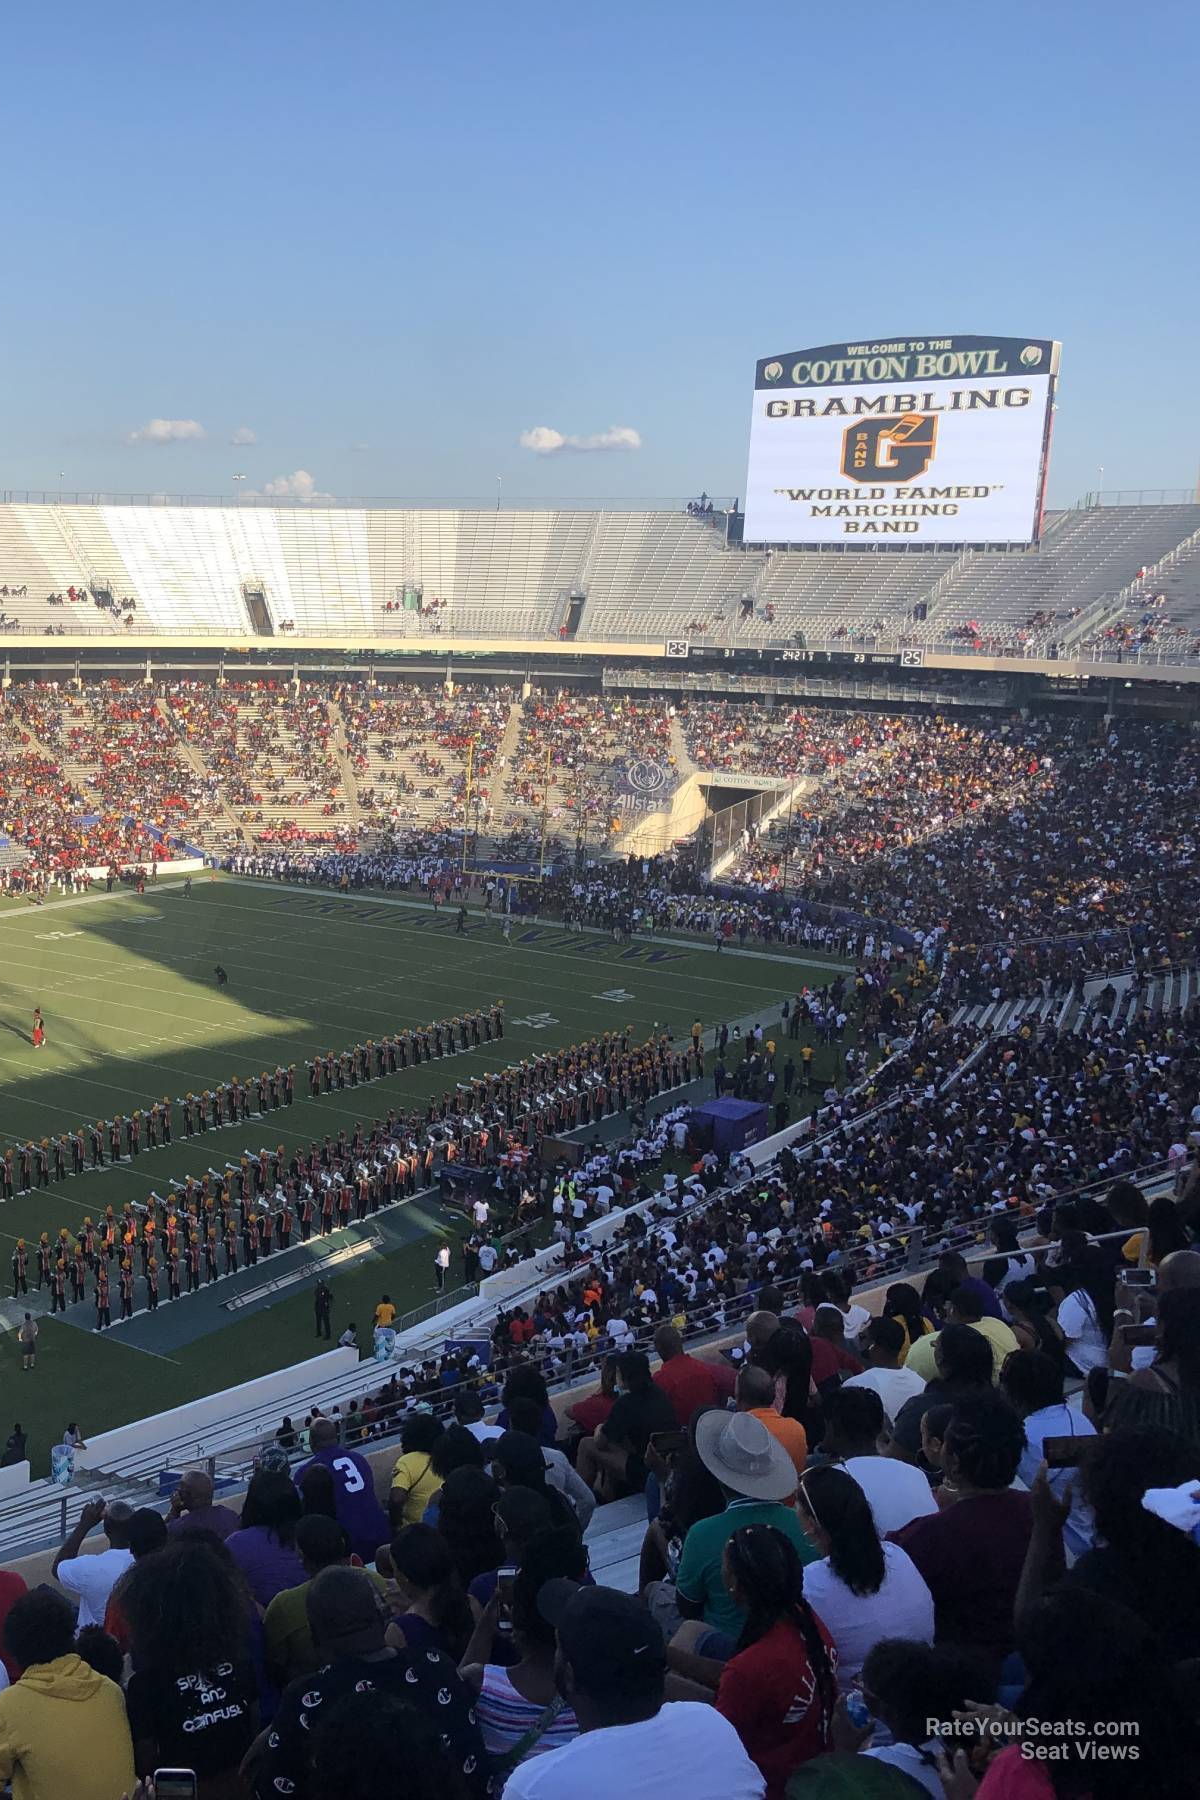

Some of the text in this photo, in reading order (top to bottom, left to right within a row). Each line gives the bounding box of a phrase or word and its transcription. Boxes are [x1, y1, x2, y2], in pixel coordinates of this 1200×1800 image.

[847, 339, 953, 356] WELCOME TO THE
[792, 350, 1007, 384] COTTON BOWL
[766, 387, 1032, 418] GRAMBLING
[854, 432, 868, 468] BAND
[810, 503, 959, 517] MARCHING
[843, 521, 920, 533] BAND
[669, 642, 686, 655] 25
[724, 648, 735, 658] 31
[854, 653, 865, 663] 23
[904, 651, 921, 664] 25
[333, 1456, 364, 1493] 3
[201, 1687, 227, 1704] AND
